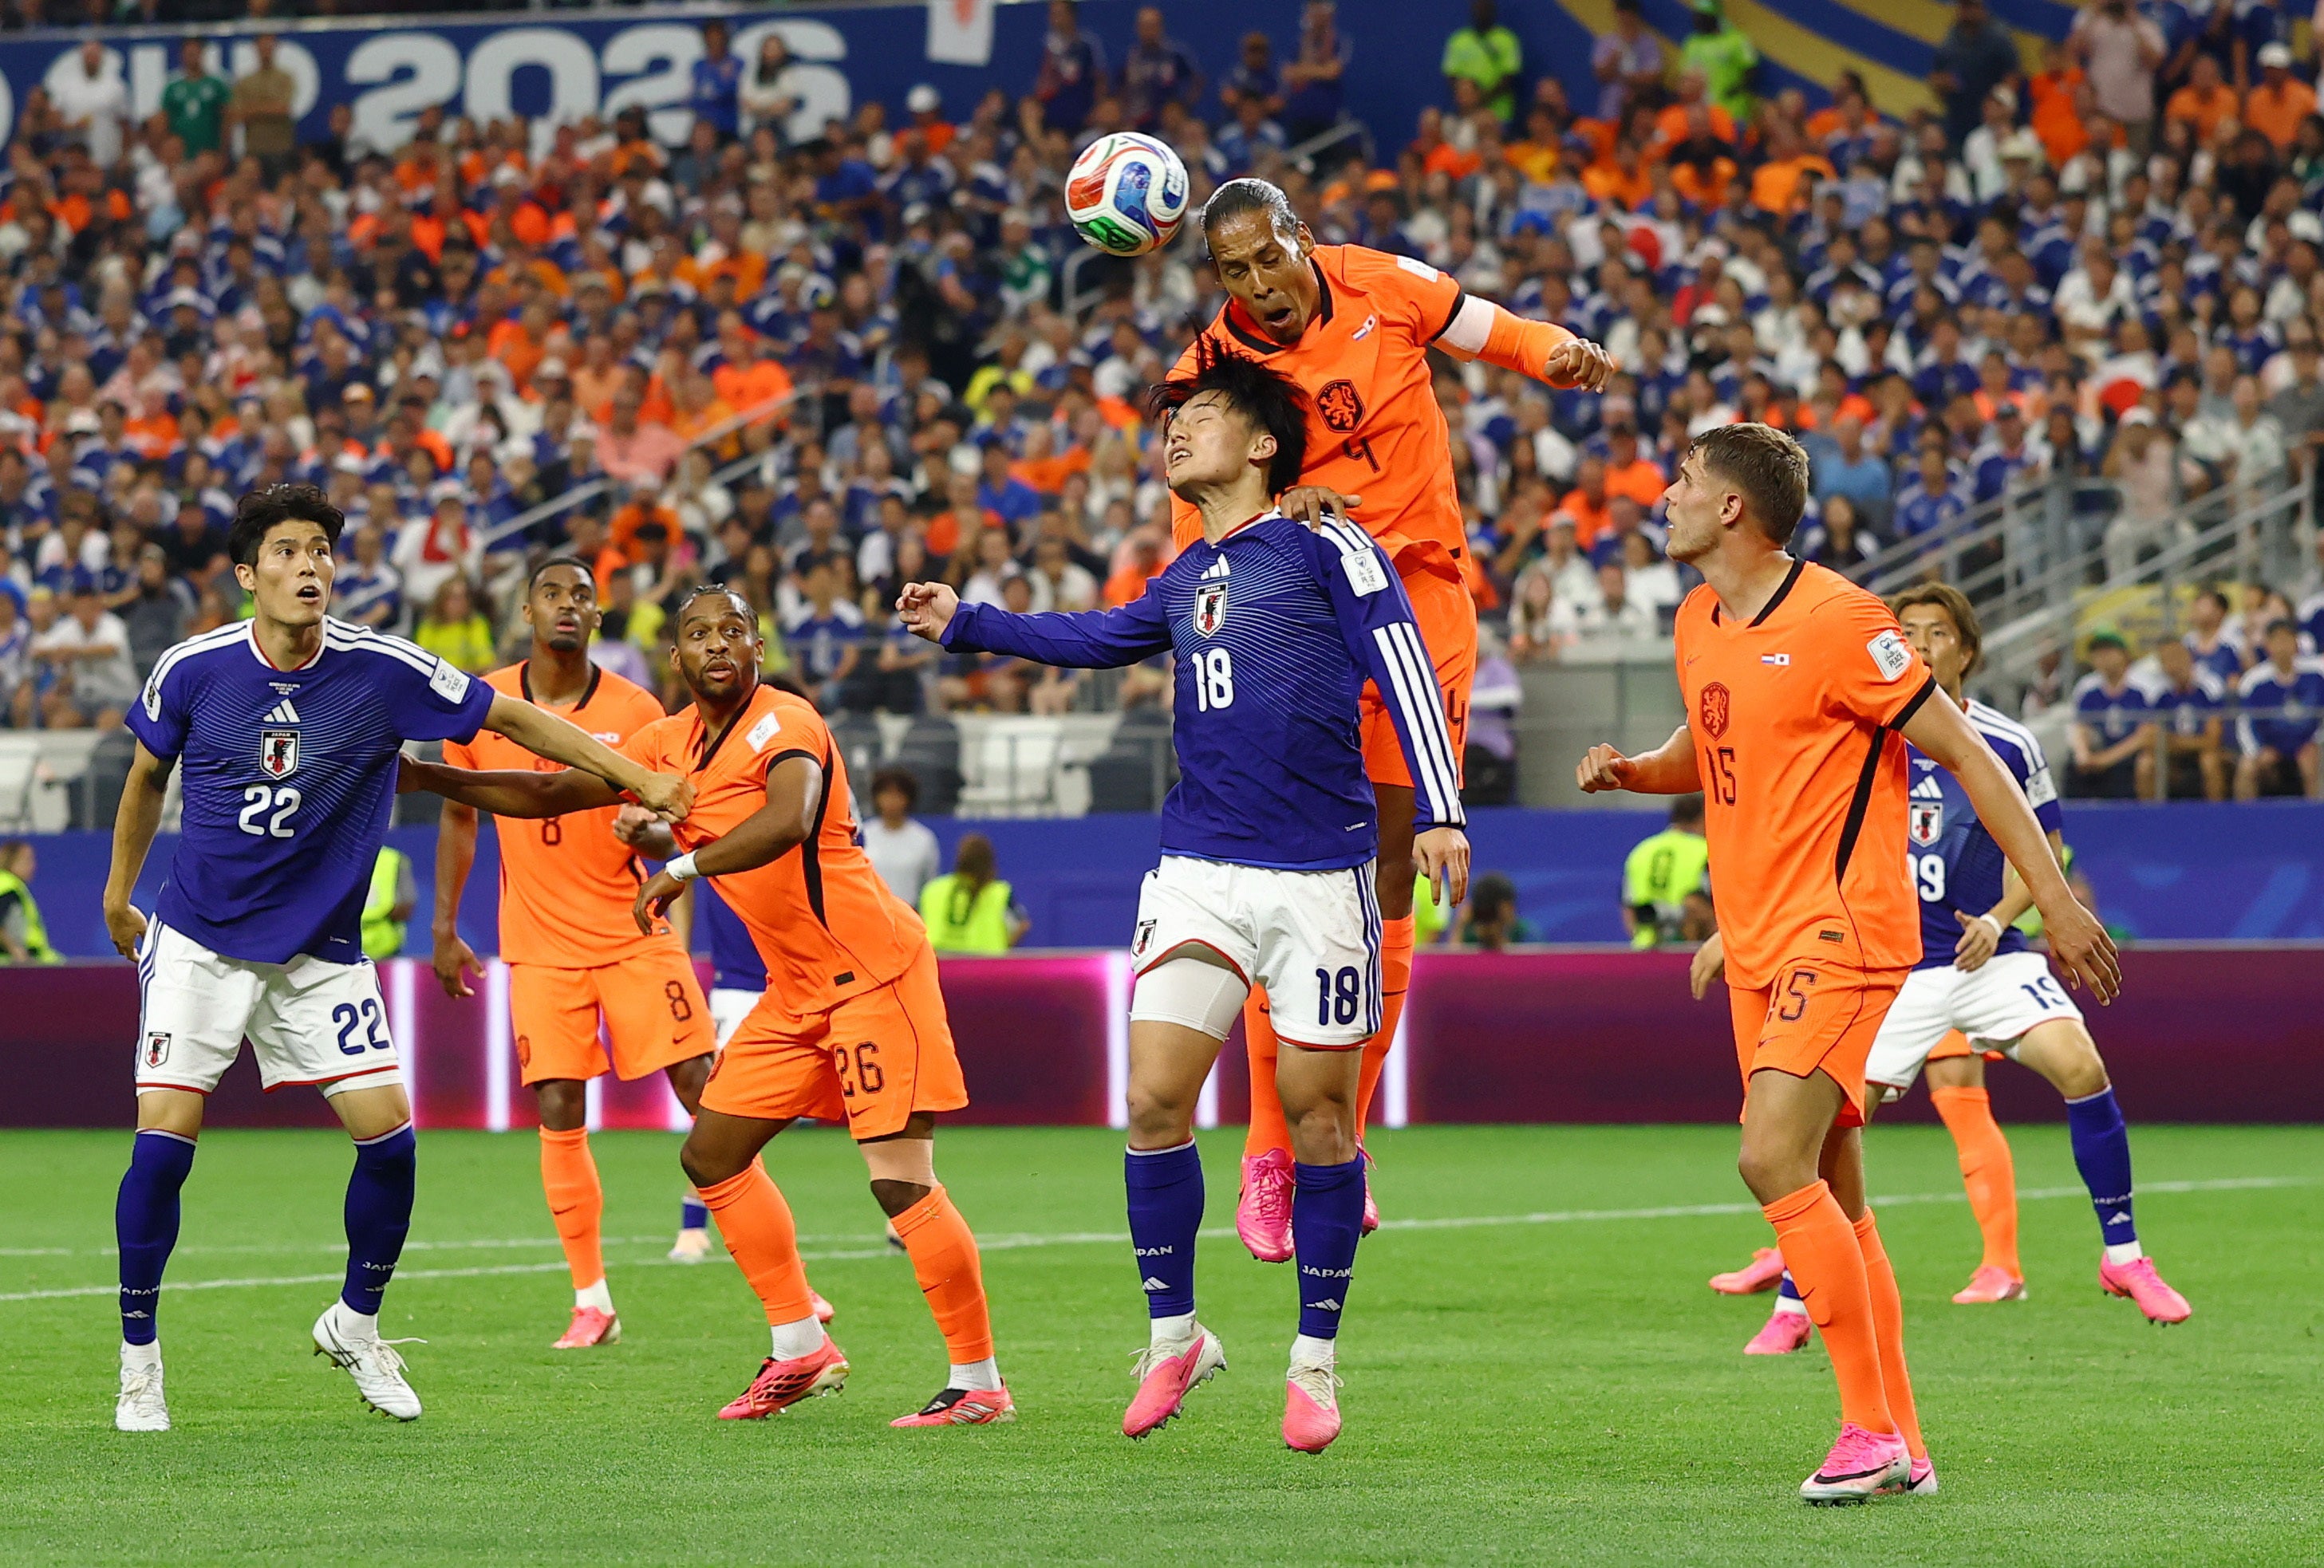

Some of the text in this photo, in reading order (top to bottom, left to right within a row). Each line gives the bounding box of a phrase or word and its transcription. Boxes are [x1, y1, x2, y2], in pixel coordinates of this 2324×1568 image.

[345, 18, 851, 163] 2026
[1343, 437, 1380, 474] 4
[1192, 648, 1234, 712] 18
[1447, 688, 1466, 745] 4
[1706, 746, 1736, 806] 15
[239, 784, 302, 837] 22
[664, 980, 692, 1022] 8
[1316, 965, 1359, 1026] 18
[333, 998, 389, 1055] 22
[834, 1041, 885, 1097] 26
[1133, 1245, 1173, 1257] PAN
[1302, 1265, 1351, 1278] JAPAN
[120, 1282, 160, 1296] APAN
